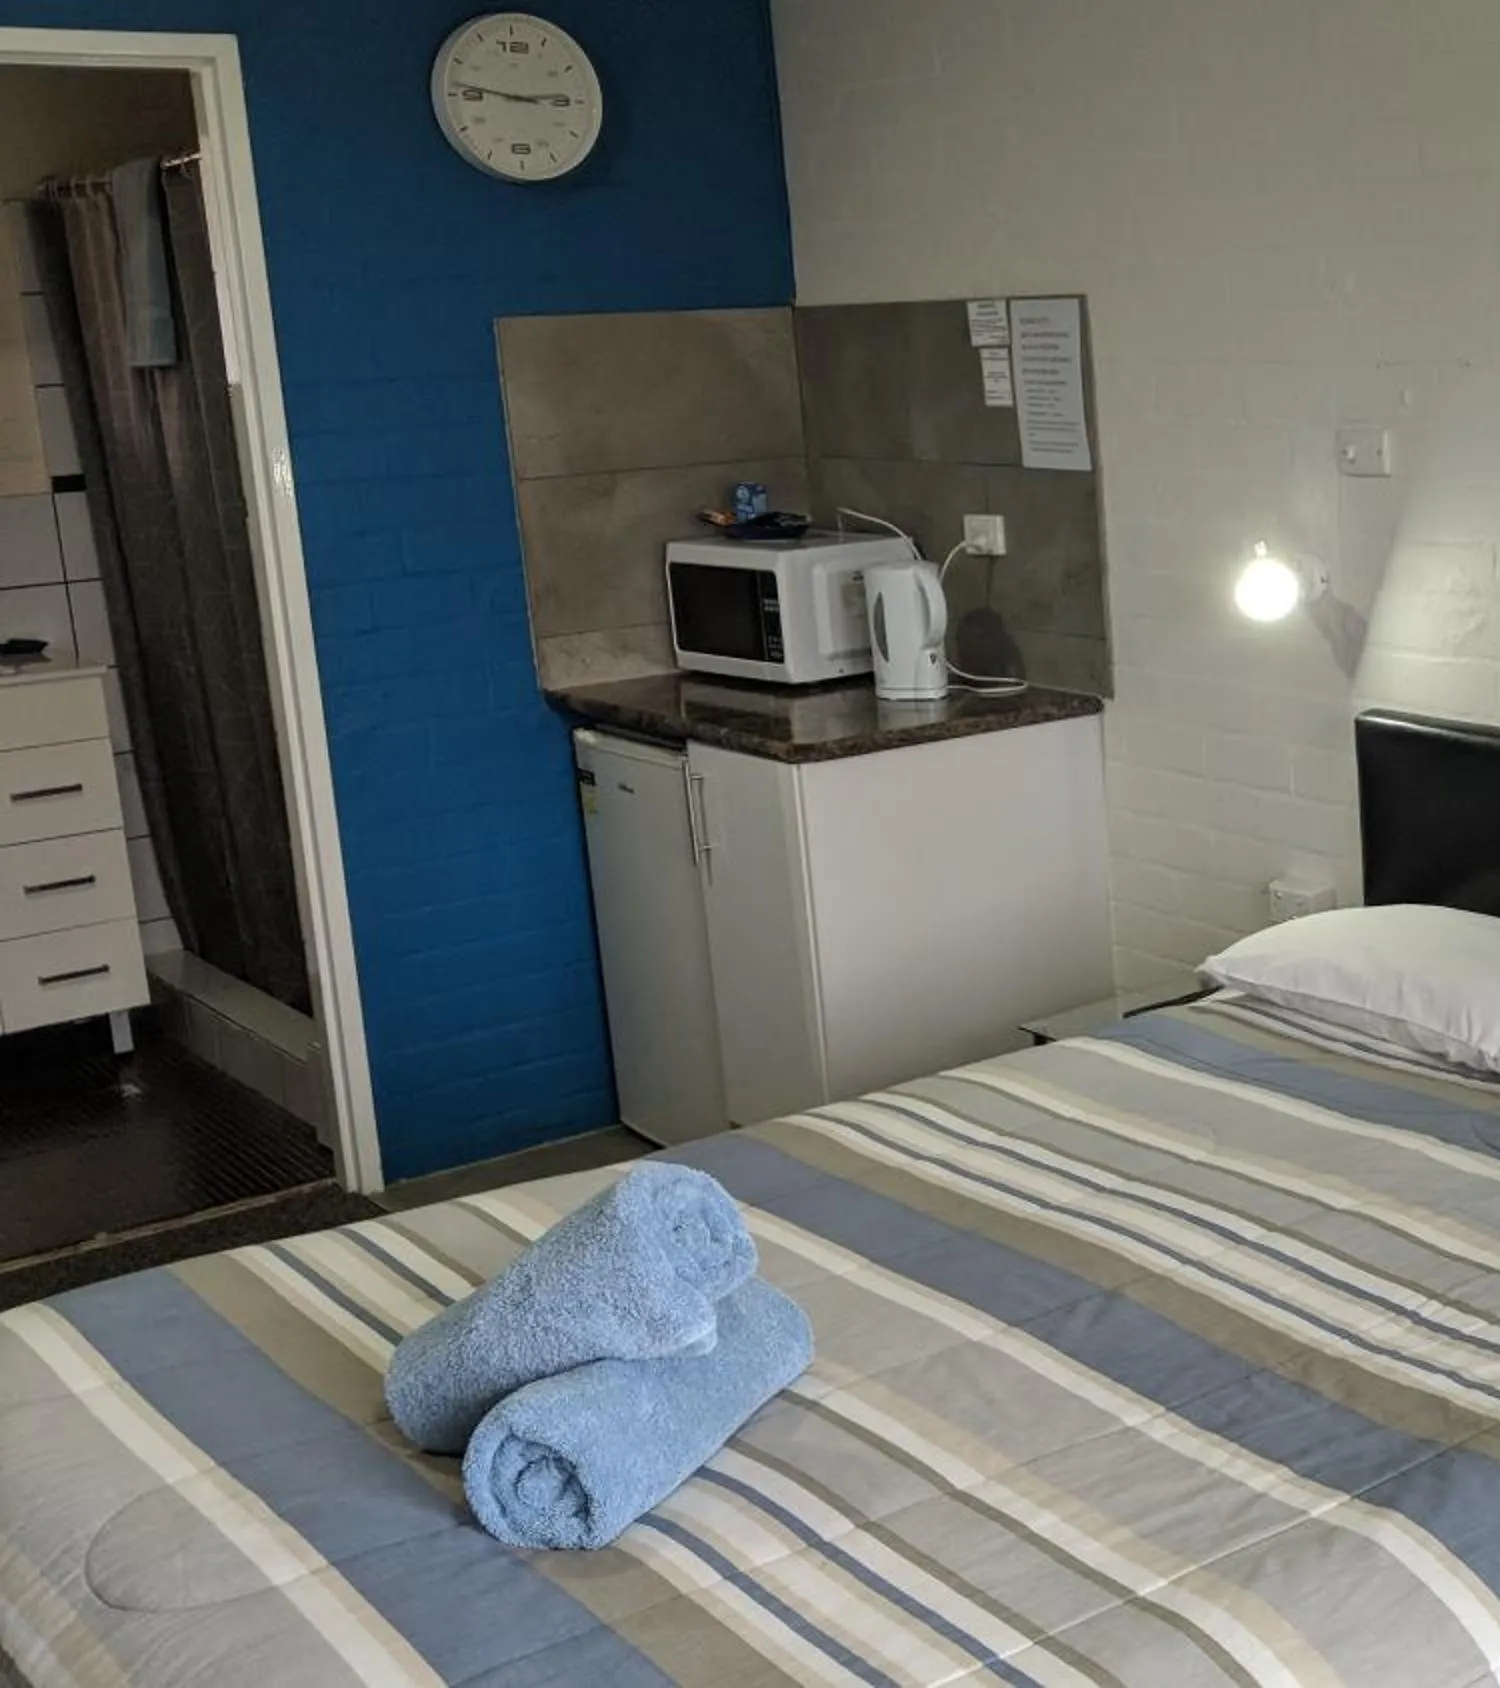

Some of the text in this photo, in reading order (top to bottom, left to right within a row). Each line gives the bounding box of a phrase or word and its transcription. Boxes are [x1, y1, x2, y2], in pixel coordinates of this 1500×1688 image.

[496, 40, 529, 54] 12
[461, 89, 484, 101] 9
[511, 143, 531, 155] 6
